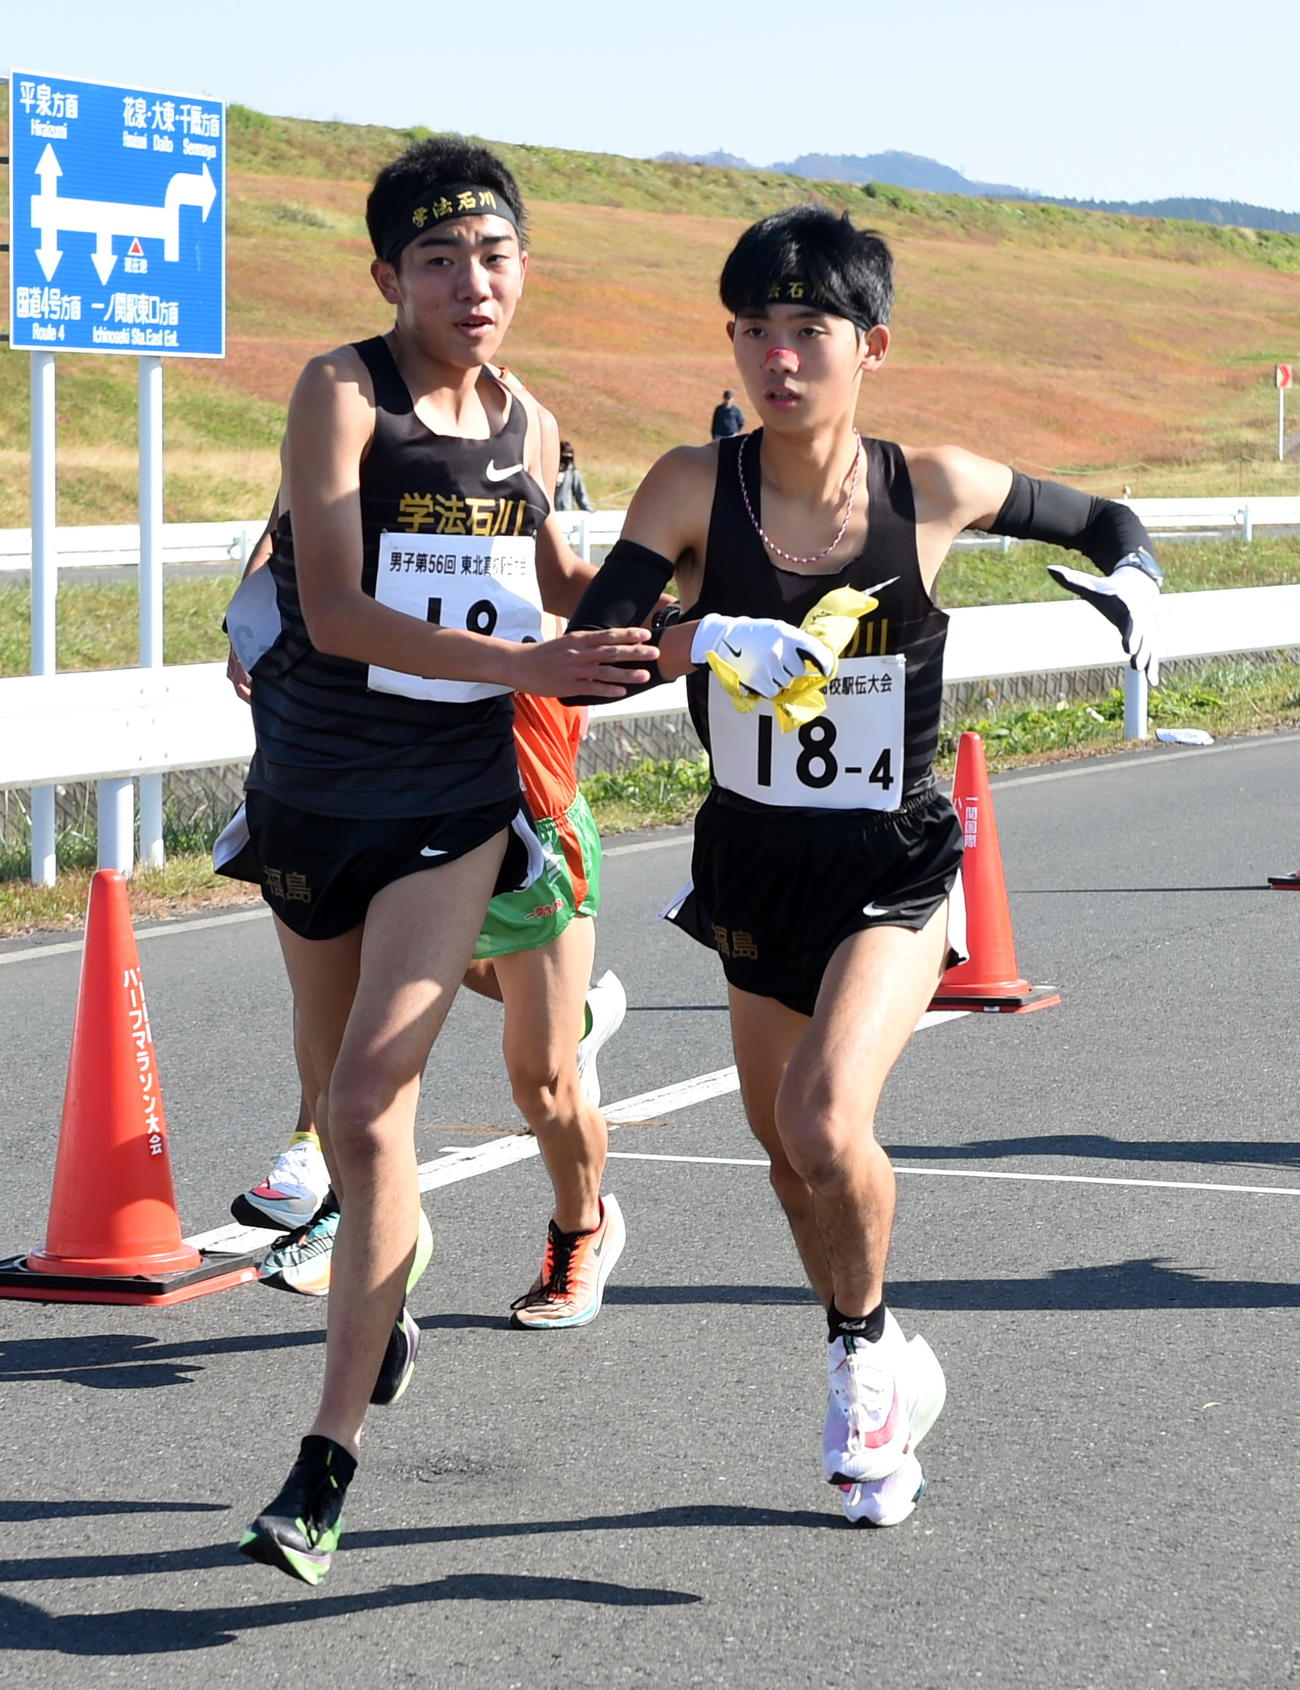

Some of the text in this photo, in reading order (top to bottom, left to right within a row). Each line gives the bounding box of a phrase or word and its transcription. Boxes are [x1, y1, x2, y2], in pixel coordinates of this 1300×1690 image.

[19, 81, 79, 119] 平泉方面
[411, 190, 498, 228] 学法石川
[16, 286, 82, 320] 国道4号方面
[32, 322, 65, 341] Route 4
[397, 492, 527, 536] 学法石川
[389, 551, 457, 575] 男子第56回
[757, 714, 894, 791] 18-4
[264, 864, 312, 903] 福島
